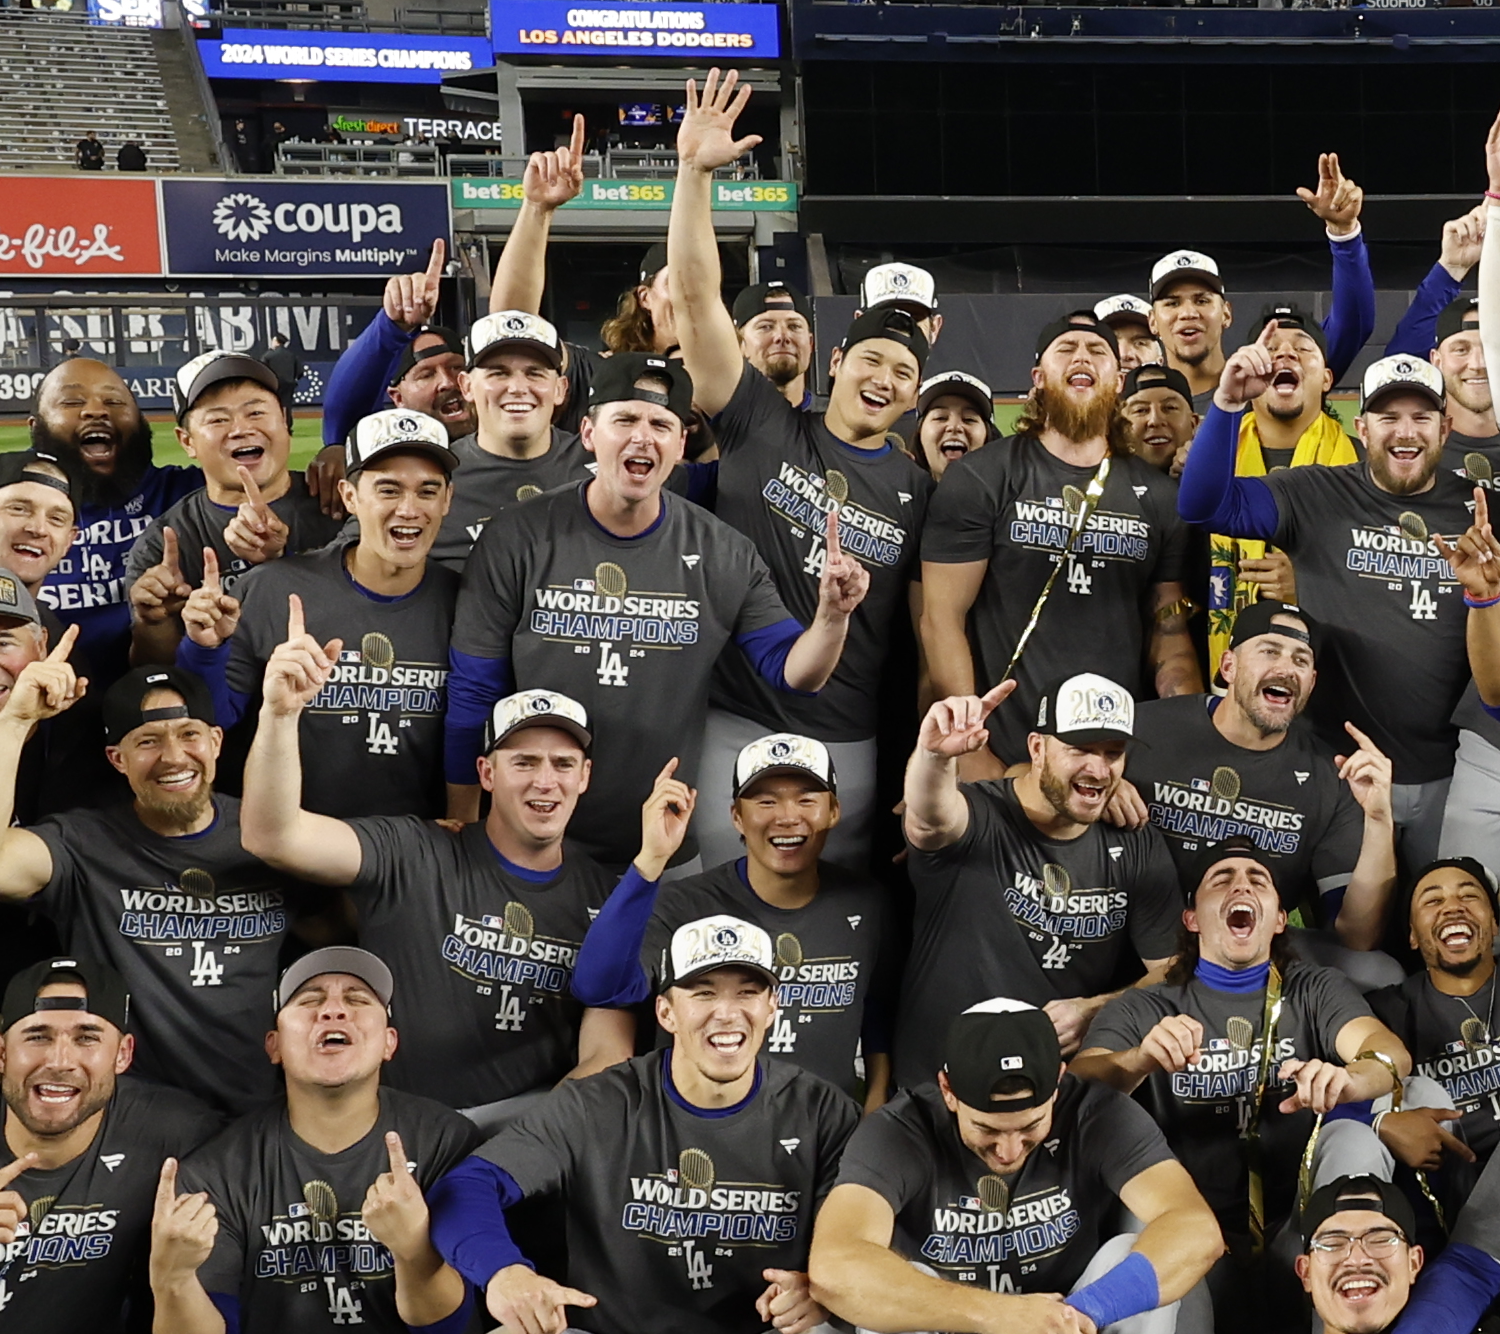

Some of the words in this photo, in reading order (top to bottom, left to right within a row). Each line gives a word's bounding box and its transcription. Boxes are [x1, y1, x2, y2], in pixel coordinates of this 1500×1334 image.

[567, 8, 704, 29] CONGRATULATIONS
[519, 29, 558, 44] LOS
[561, 29, 653, 46] ANGELES
[656, 31, 752, 48] DODGERS
[221, 43, 263, 64] 2024
[265, 46, 320, 66] WORLD
[323, 47, 377, 67] SERIES
[377, 48, 471, 70] CHAMPIONS
[404, 117, 501, 141] TERRACE
[592, 183, 664, 201] bet365
[718, 185, 787, 202] bet365
[275, 203, 403, 242] coupa
[216, 248, 260, 263] Make
[264, 248, 331, 266] Margins
[535, 588, 619, 617] WORLD
[621, 595, 699, 620] SERIES
[529, 609, 698, 644] CHAMPIONS
[597, 642, 628, 687] LA
[120, 888, 214, 914] WORLD
[218, 889, 284, 912] SERIES
[119, 910, 285, 940] CHAMPIONS
[190, 941, 223, 986] LA
